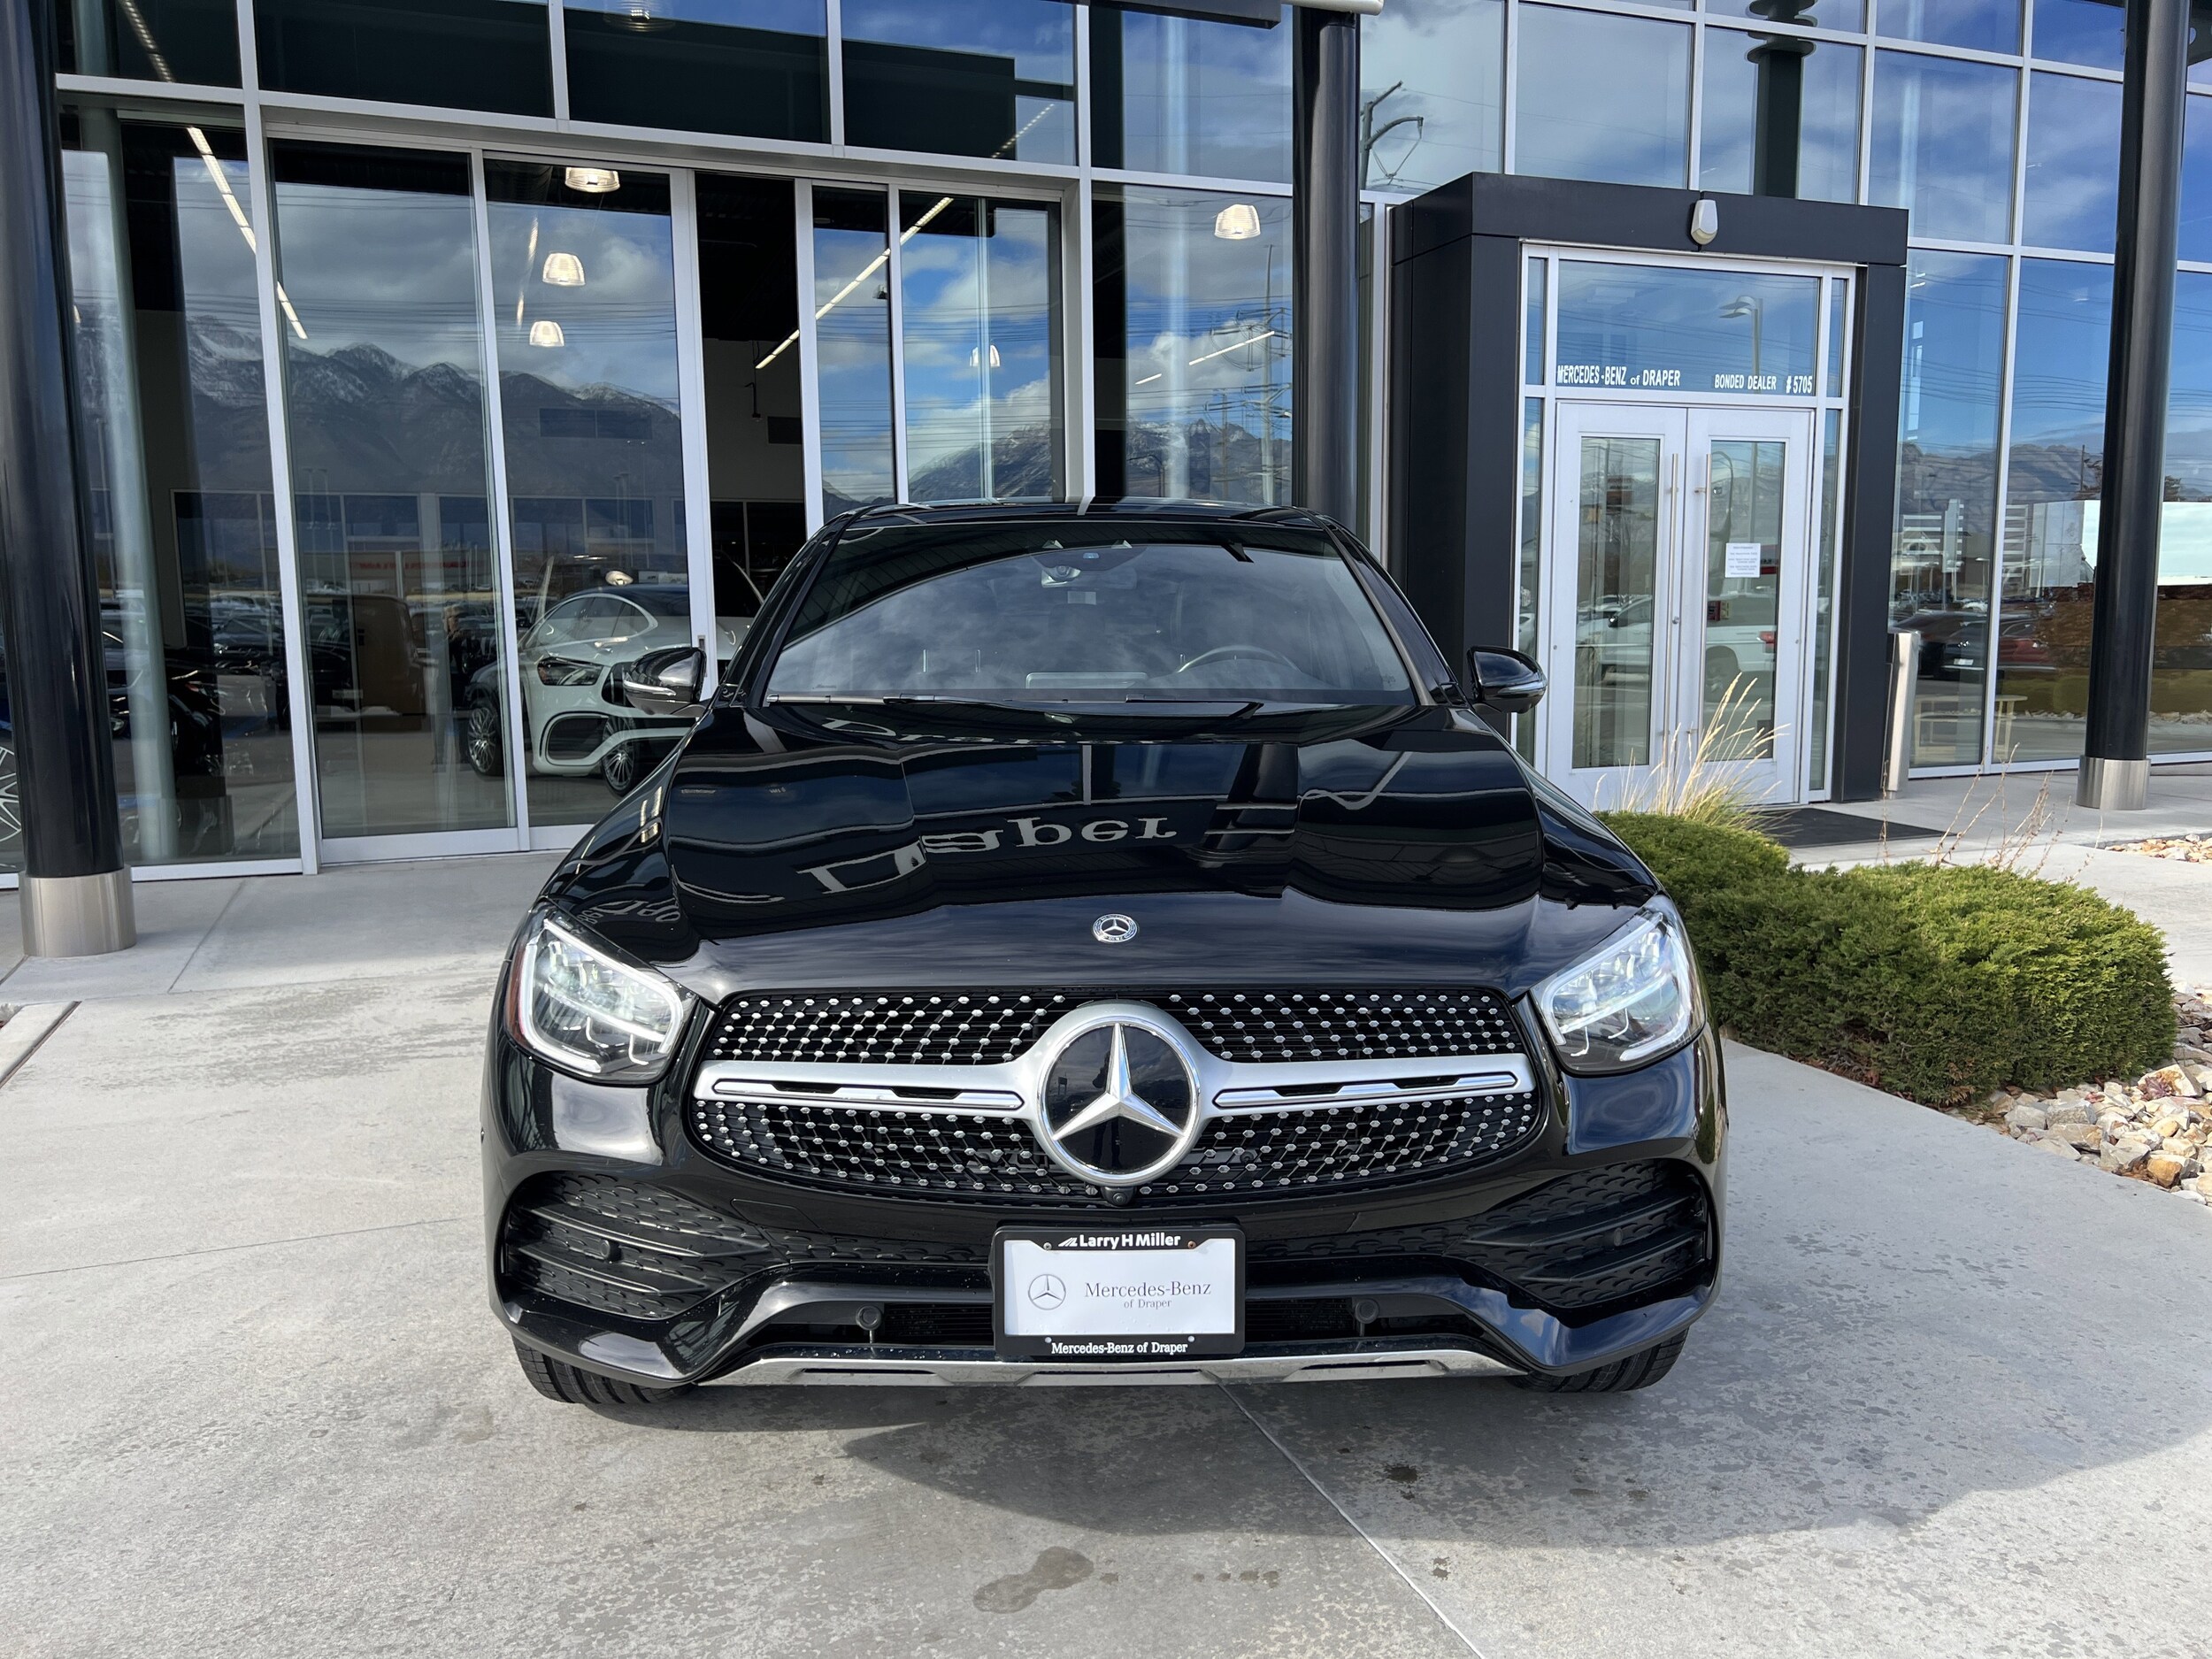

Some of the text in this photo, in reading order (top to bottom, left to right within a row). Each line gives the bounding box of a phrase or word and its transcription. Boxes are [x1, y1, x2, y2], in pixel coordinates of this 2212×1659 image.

[1630, 374, 1641, 386] of
[1642, 369, 1681, 387] DRAPER
[1714, 373, 1745, 389] BONDED
[1747, 374, 1778, 390] DEALER
[1079, 1232, 1181, 1250] Larry H Miller
[1085, 1280, 1212, 1298] Mercedes-Benz
[1123, 1298, 1172, 1310] of Draper
[1051, 1341, 1188, 1356] Mercedes-Benz of Draper
